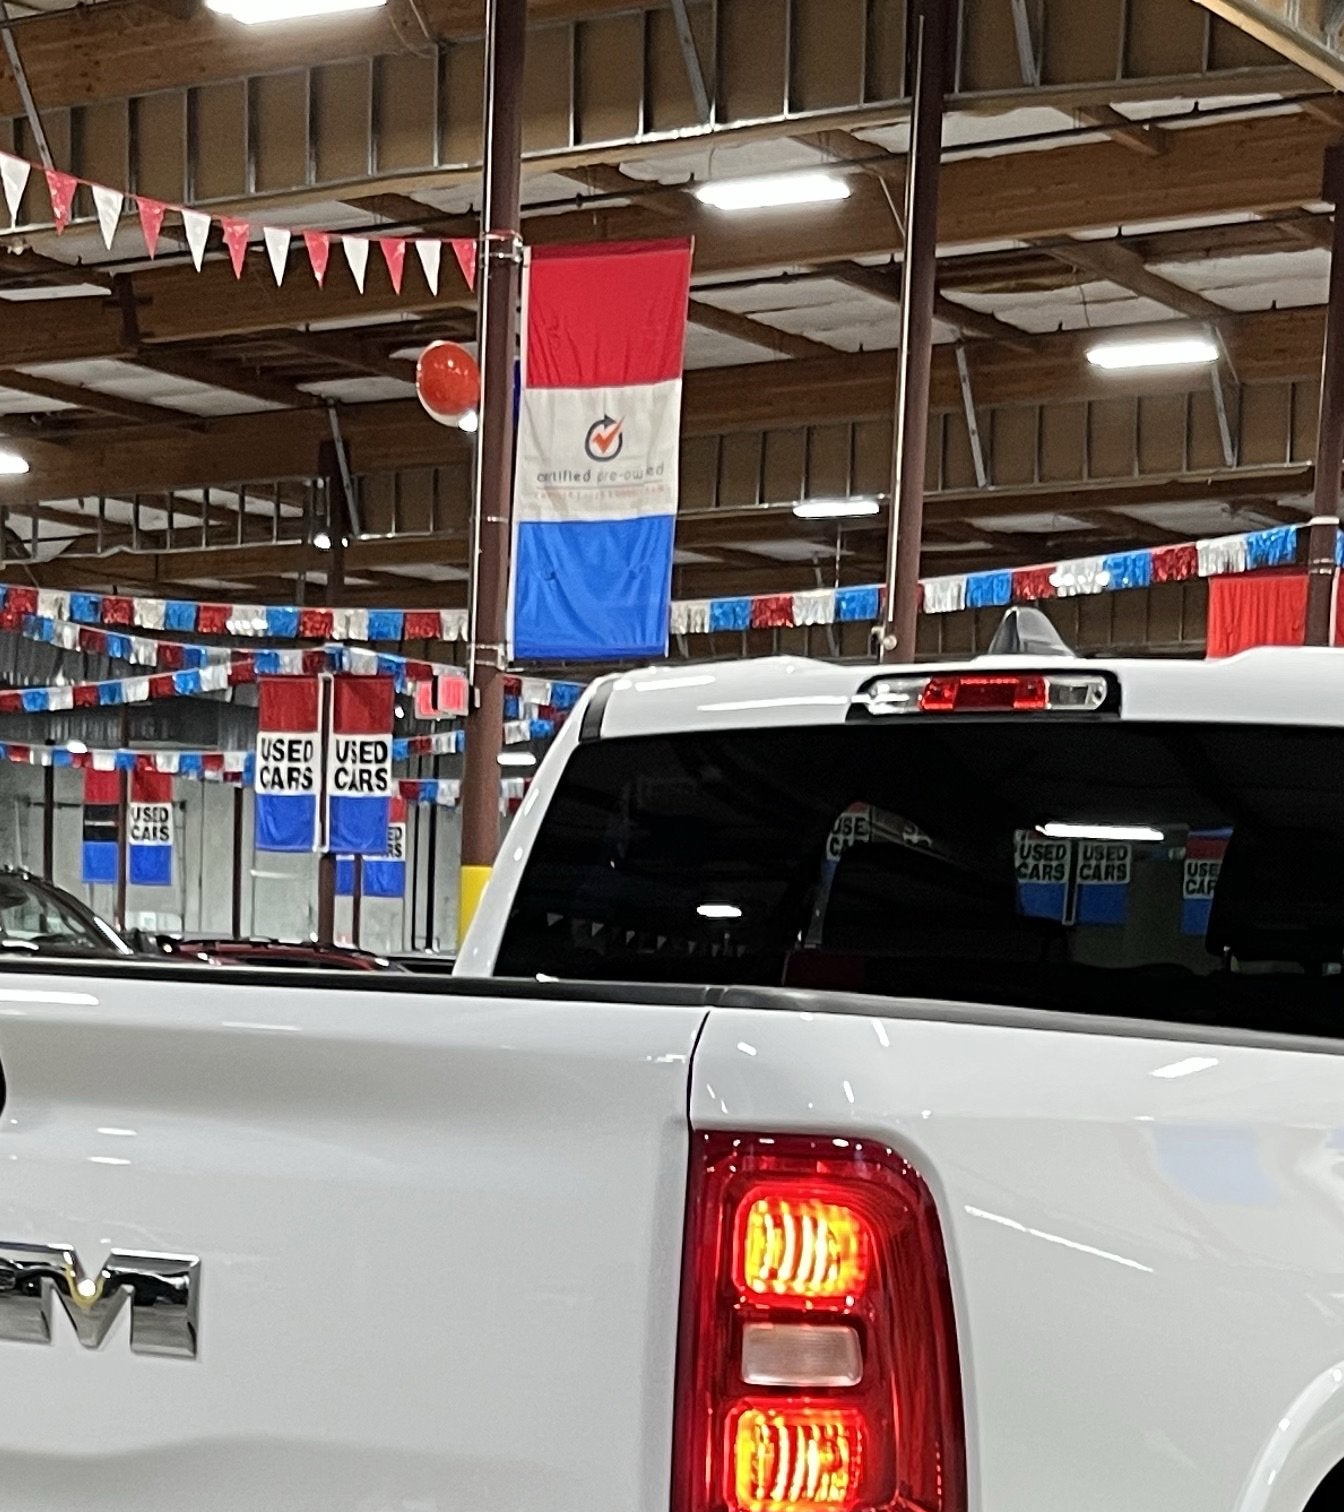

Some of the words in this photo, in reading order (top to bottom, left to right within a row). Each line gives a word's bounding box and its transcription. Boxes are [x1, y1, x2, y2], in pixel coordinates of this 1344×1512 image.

[596, 463, 665, 483] pre-owed
[261, 737, 314, 763] USED
[335, 739, 388, 764] USED
[259, 766, 314, 790] CARS
[334, 767, 389, 792] CARS
[131, 806, 169, 824] USED
[1019, 842, 1066, 861] USED
[1082, 843, 1128, 862] USED
[1017, 862, 1066, 881] CARS
[1080, 862, 1128, 881] CARS
[1187, 861, 1218, 878] USE
